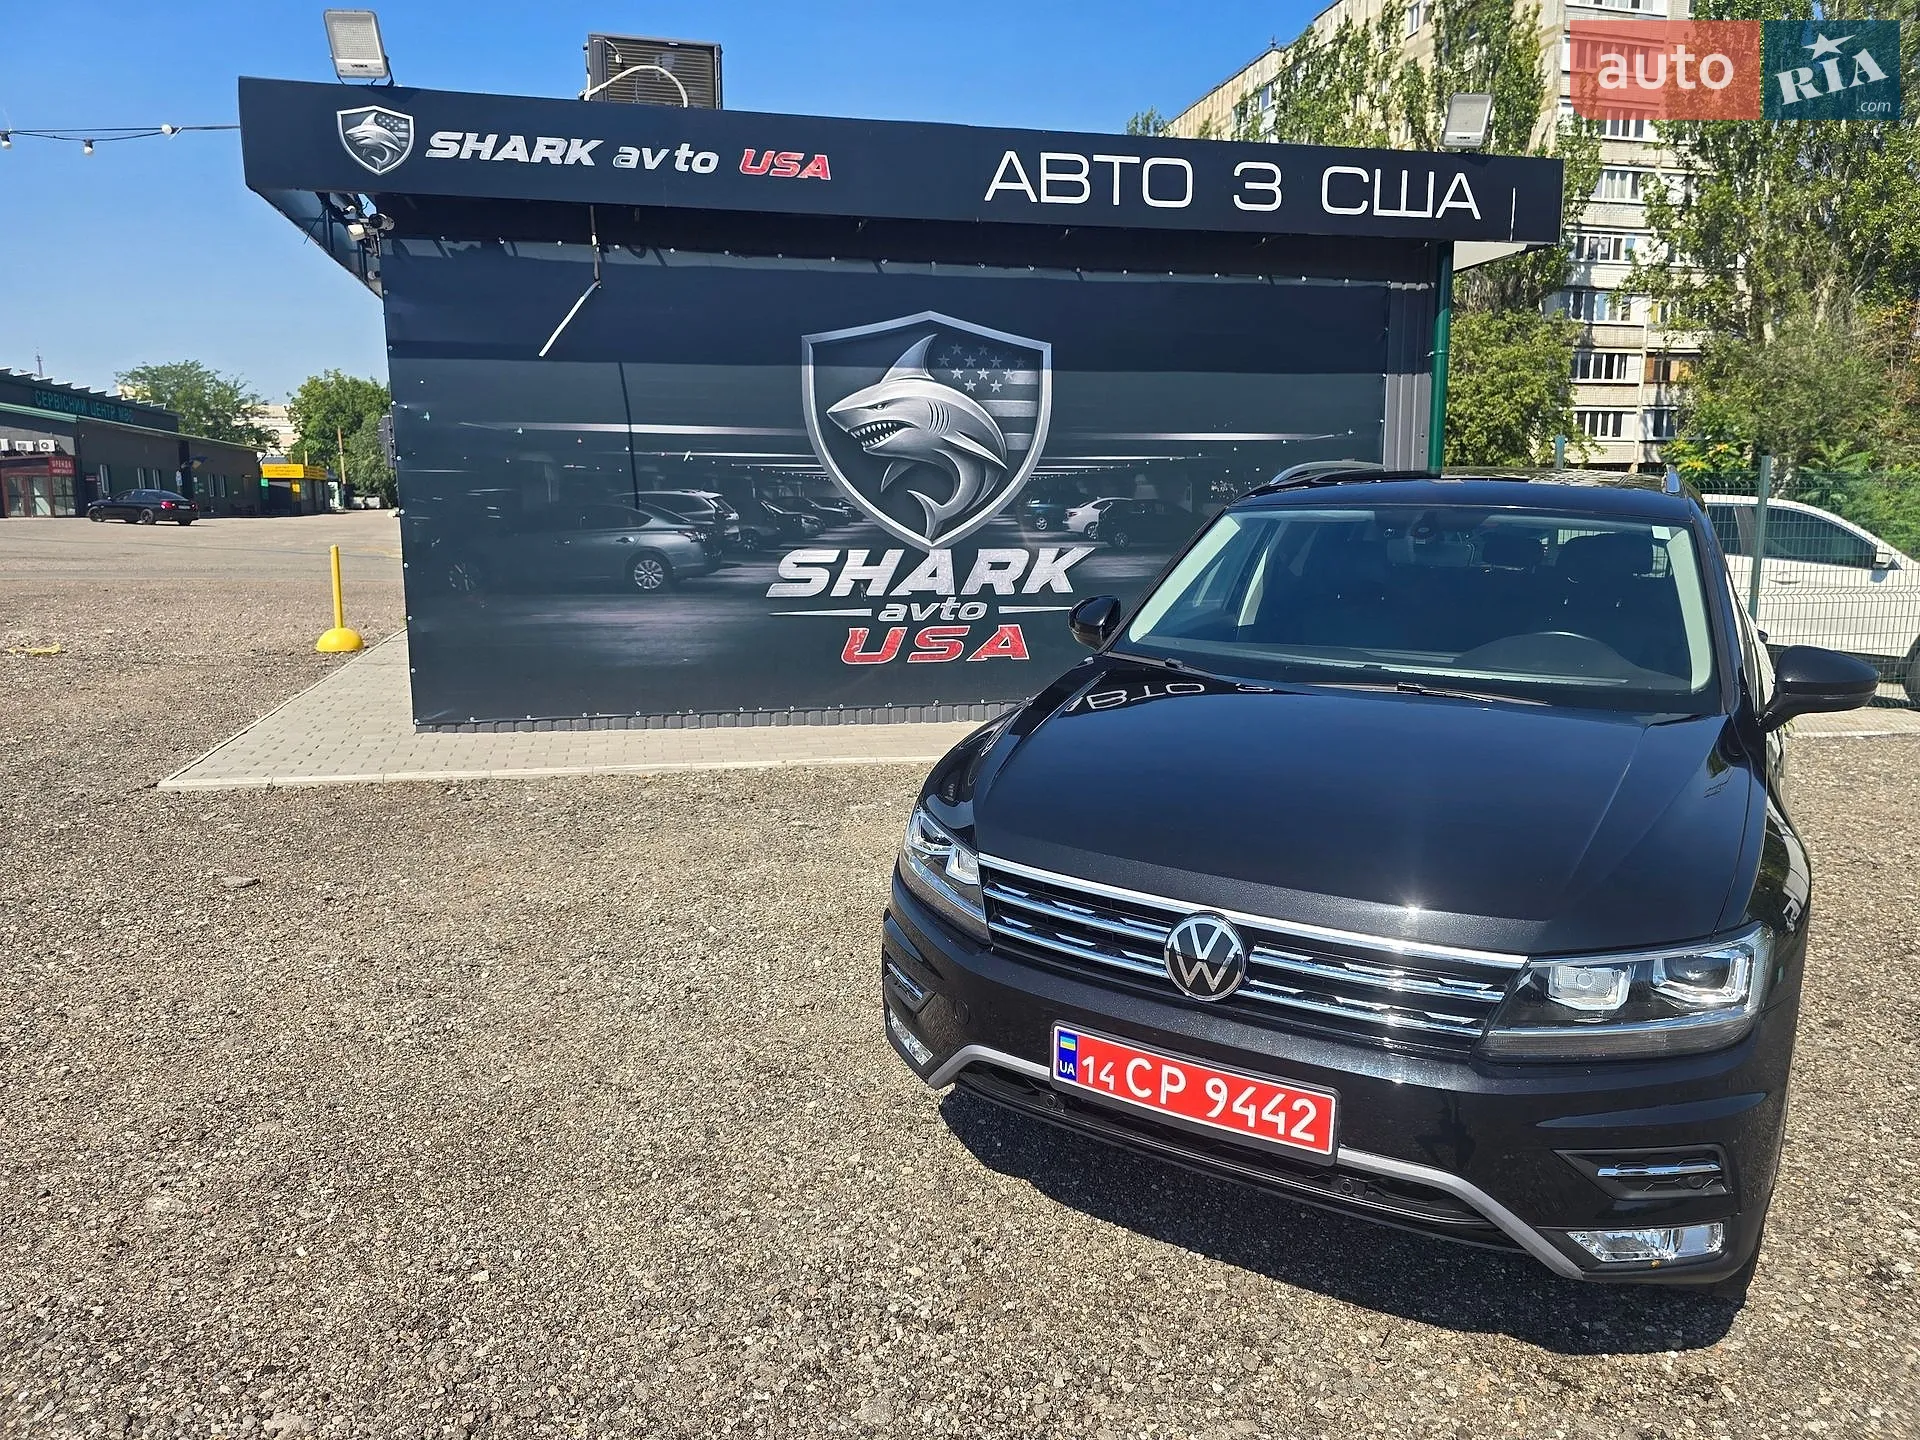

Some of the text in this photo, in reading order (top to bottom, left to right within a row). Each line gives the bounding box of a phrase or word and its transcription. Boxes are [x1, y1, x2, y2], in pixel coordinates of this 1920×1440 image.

[425, 131, 603, 166] SHARK
[738, 149, 832, 181] USA
[984, 150, 1194, 208] АВТО
[1321, 166, 1482, 220] США
[766, 547, 1096, 598] SHARK
[878, 597, 988, 622] avto
[840, 624, 1030, 665] USA
[1059, 1061, 1076, 1077] UA
[1081, 1055, 1317, 1142] 14 CP 9442
